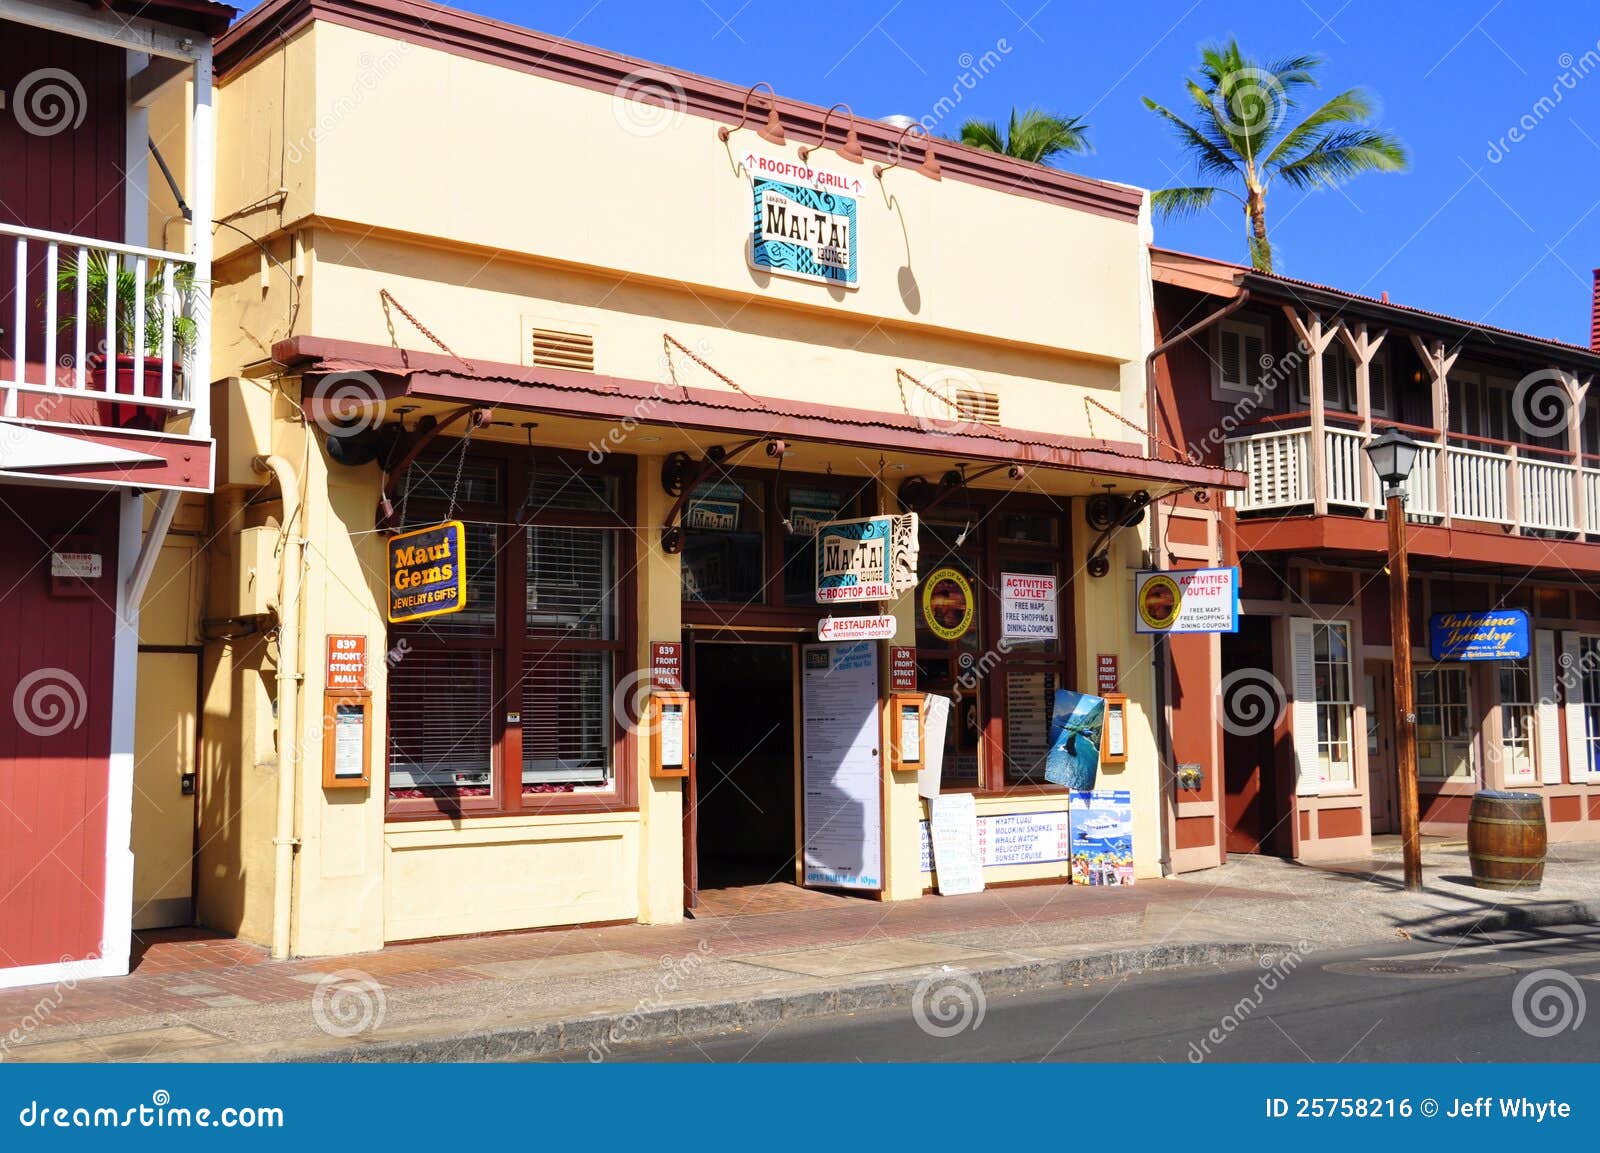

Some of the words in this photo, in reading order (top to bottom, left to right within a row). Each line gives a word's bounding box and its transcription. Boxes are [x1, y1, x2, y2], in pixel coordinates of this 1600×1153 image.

[759, 157, 814, 181] ROOFTOP
[817, 172, 850, 190] GRILL
[766, 203, 847, 249] MAI-TAI
[395, 537, 451, 568] Maui
[825, 542, 883, 572] MAI-TAI
[394, 563, 453, 590] Gems
[1180, 575, 1229, 585] ACTIVITIES
[1006, 578, 1054, 590] ACTIVITIES
[827, 586, 863, 599] ROOFTOP
[865, 584, 889, 597] GRILL
[1013, 588, 1047, 598] OUTLET
[1187, 586, 1222, 596] OUTLET
[393, 592, 427, 610] JEWELRY
[427, 591, 434, 603] &
[434, 587, 457, 602] GIFTS
[1014, 601, 1029, 610] FREE
[1030, 602, 1045, 611] MAPS
[1005, 612, 1020, 621] FREE
[1020, 613, 1049, 622] SHOPPING
[833, 618, 891, 631] RESTAURANT
[1006, 623, 1027, 633] DINING
[1027, 624, 1054, 634] COUPONS
[336, 639, 357, 649] 839
[659, 646, 675, 655] 839
[897, 650, 910, 659] 839
[332, 651, 361, 661] FRONT
[655, 657, 678, 665] FRONT
[330, 663, 363, 672] STREET
[654, 667, 680, 675] STREET
[893, 669, 915, 677] STREET
[333, 674, 358, 684] MALL
[657, 677, 676, 685] MALL
[995, 817, 1015, 825] HYATT
[1016, 816, 1032, 824] LUAU
[995, 826, 1025, 835] MOLOKINI
[1026, 824, 1053, 833] SNORKEL
[995, 836, 1016, 844] WHALE
[1017, 834, 1039, 842] WATCH
[995, 844, 1033, 853] HELICOPTER
[995, 853, 1019, 862] SUNSET
[1020, 851, 1042, 860] CRUISE
